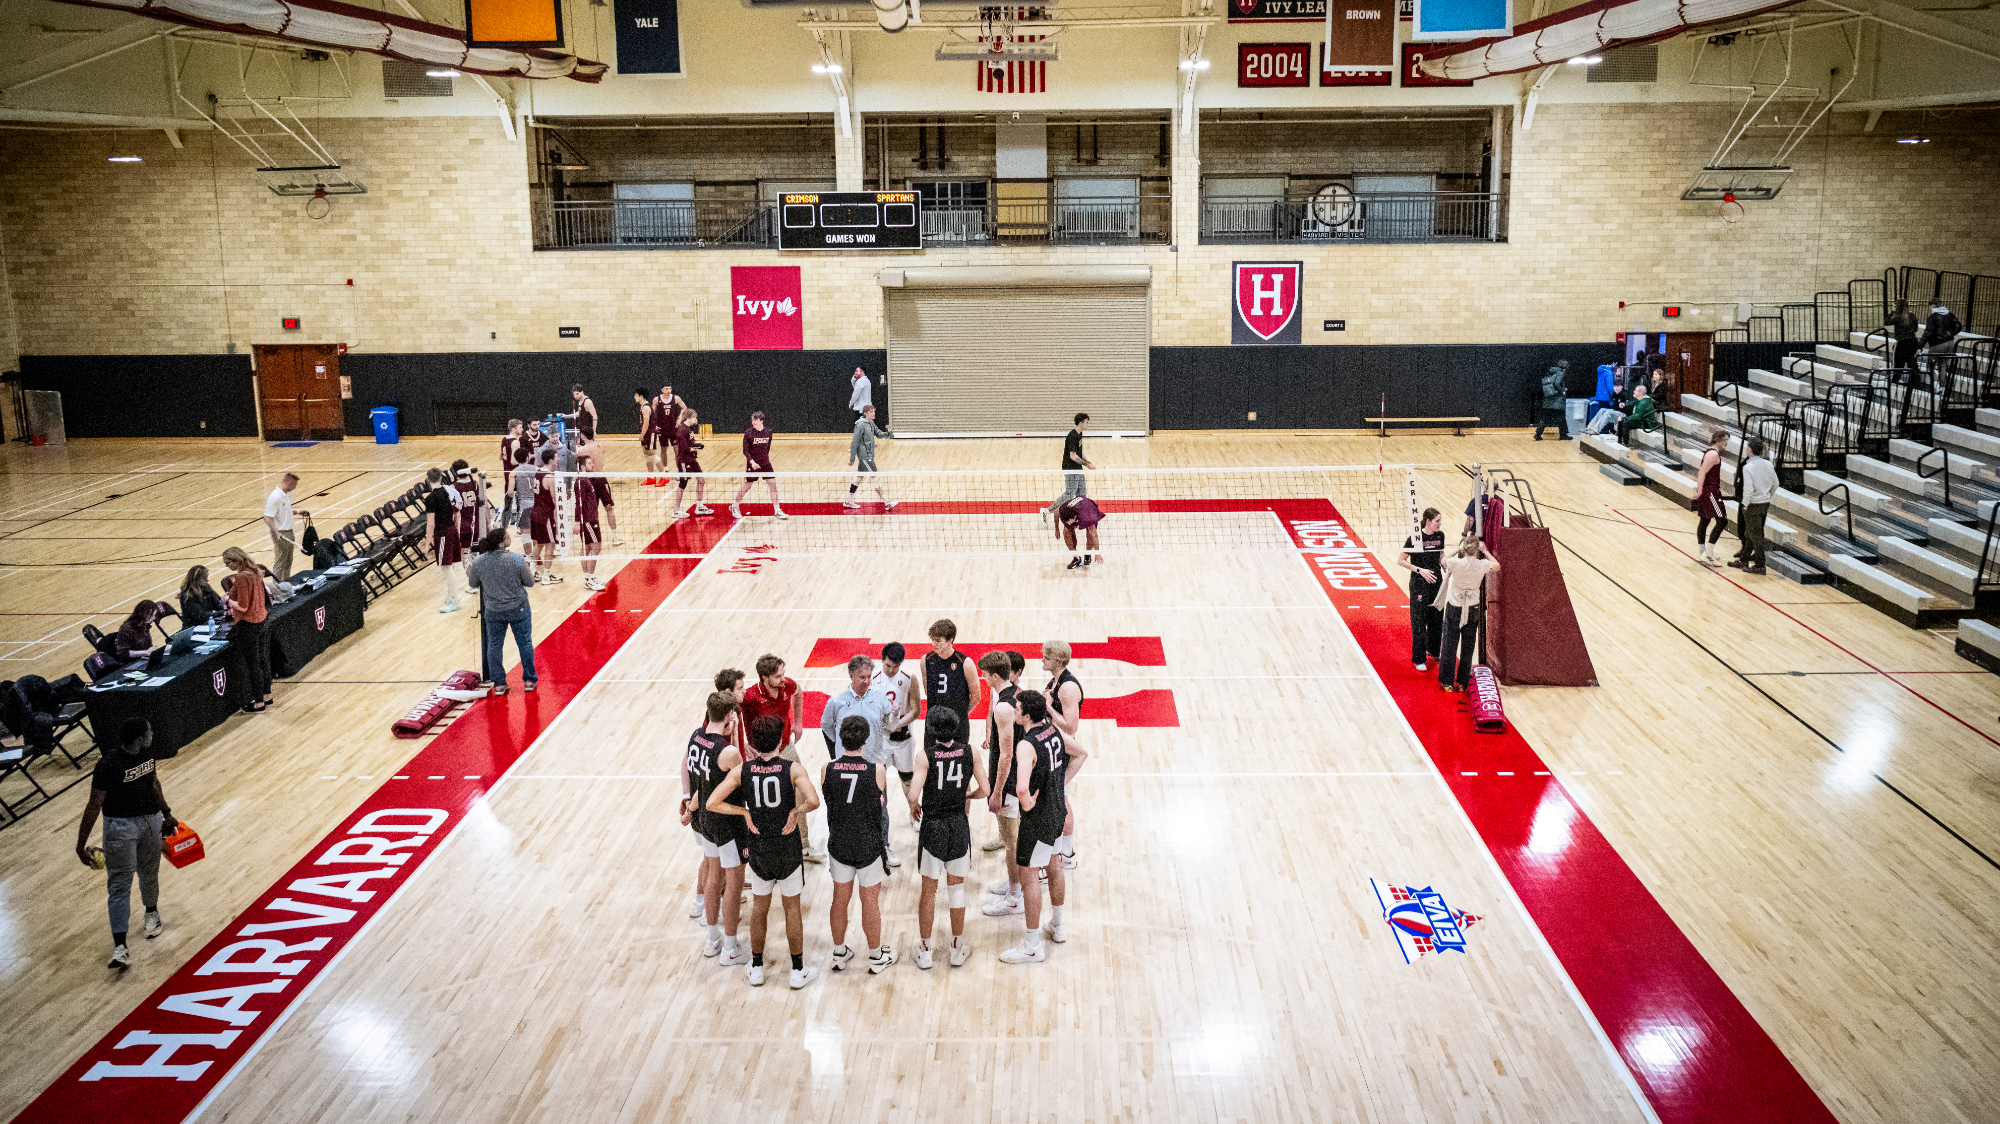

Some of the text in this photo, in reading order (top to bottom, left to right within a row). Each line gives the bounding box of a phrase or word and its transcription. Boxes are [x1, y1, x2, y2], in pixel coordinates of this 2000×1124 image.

[1265, 1, 1293, 14] IVY
[1296, 1, 1326, 14] LEA
[1345, 10, 1381, 20] BROWN
[634, 17, 659, 28] YALE
[1246, 52, 1303, 78] 2004
[786, 194, 819, 204] CRIMSON
[877, 193, 915, 203] SPARTANS
[825, 234, 876, 244] GAMES WON
[736, 295, 775, 321] Ivy
[1250, 273, 1284, 316] H
[461, 490, 477, 507] 12
[1410, 480, 1421, 542] CRIMSON
[557, 486, 566, 548] HARVARD
[1289, 520, 1389, 591] CRIMSON
[216, 672, 224, 689] H
[937, 673, 948, 694] 3
[1474, 666, 1500, 702] HARVARD
[1044, 736, 1063, 772] 12
[840, 773, 859, 804] 7
[936, 760, 964, 790] 14
[752, 776, 782, 808] 10
[1421, 895, 1463, 943] EIVA
[79, 807, 449, 1082] HARVARD
